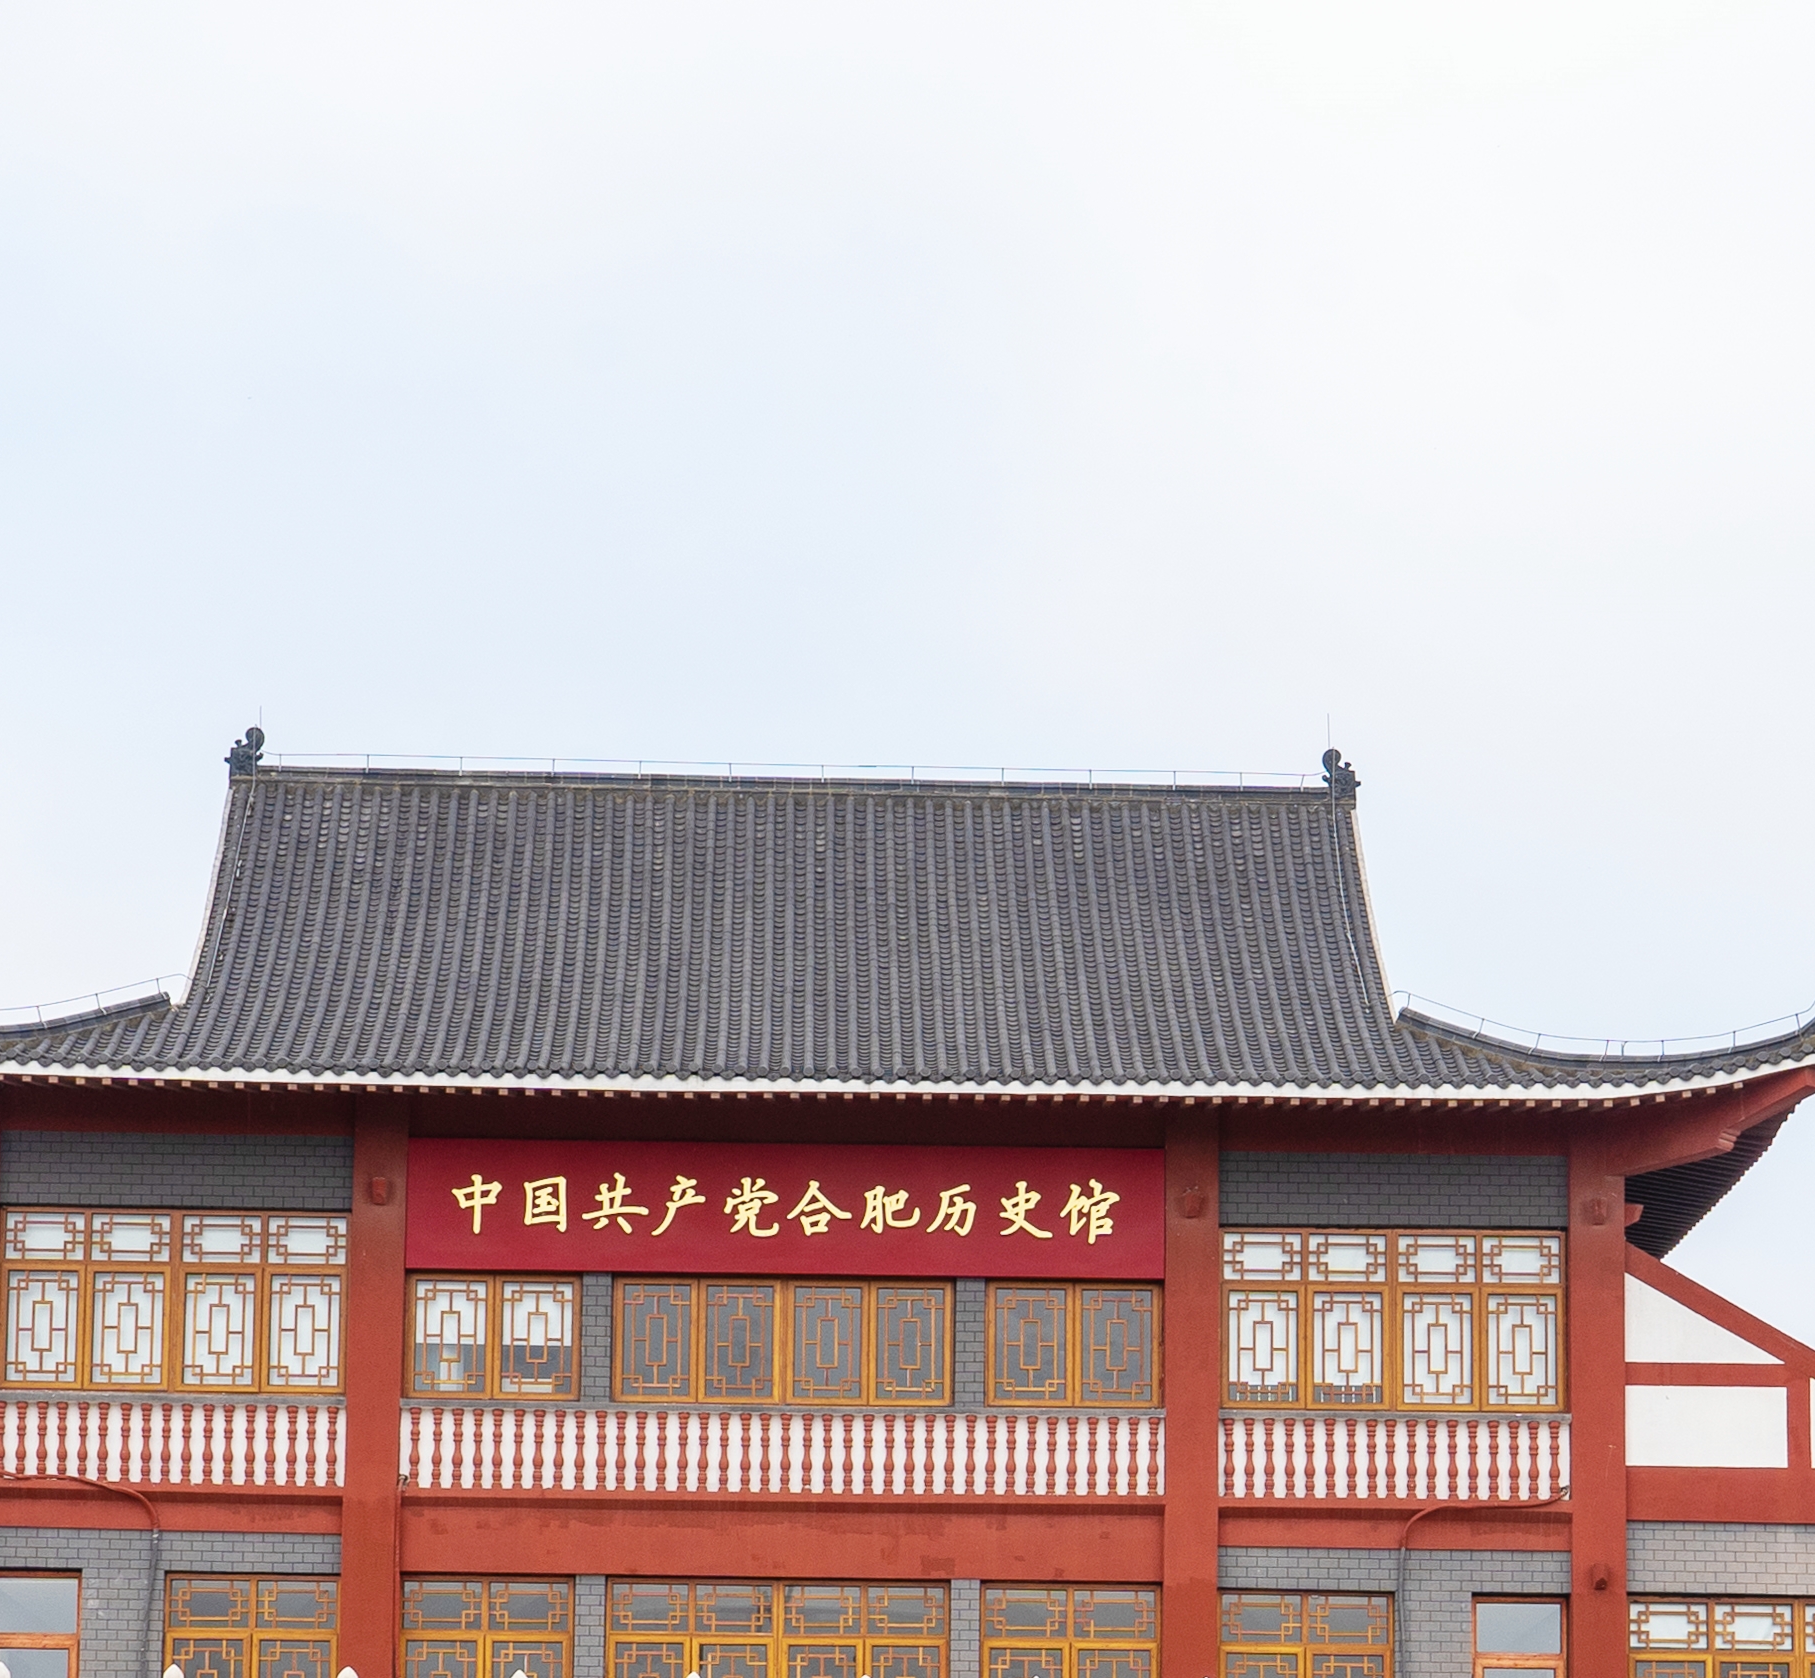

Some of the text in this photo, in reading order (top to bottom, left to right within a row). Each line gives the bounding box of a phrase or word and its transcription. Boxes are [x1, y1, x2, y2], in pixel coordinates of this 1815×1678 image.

[451, 1172, 1120, 1245] 中国共产党合肥历史馆
